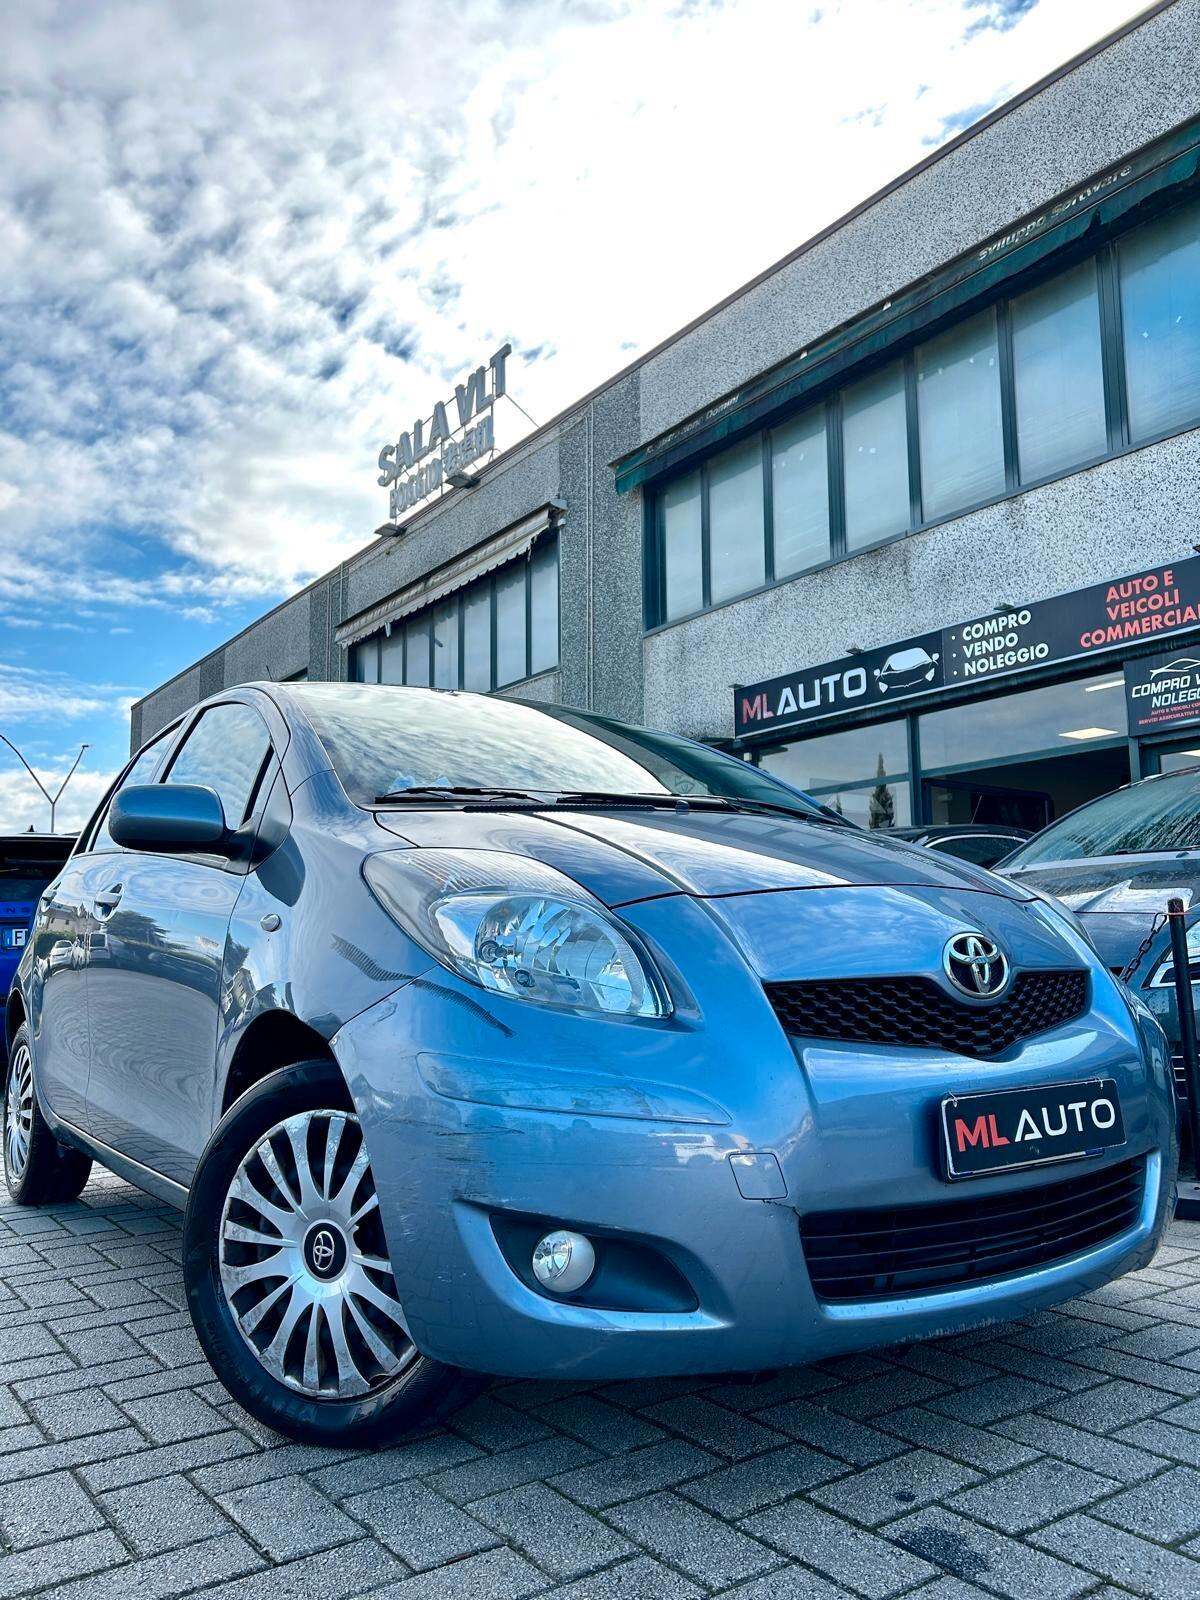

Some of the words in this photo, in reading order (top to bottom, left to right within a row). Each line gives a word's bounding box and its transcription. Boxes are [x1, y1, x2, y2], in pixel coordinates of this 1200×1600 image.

[977, 215, 1047, 261] Sviluppo
[1050, 164, 1133, 219] Software
[377, 400, 451, 488] SALA
[454, 342, 513, 427] VLT
[1106, 575, 1159, 603] AUTO
[1163, 569, 1174, 587] E
[1106, 588, 1180, 621] VEICOLI
[962, 610, 1032, 641] COMPRO
[963, 632, 1019, 659] VENDO
[964, 643, 1049, 677] NOLEGGIO
[741, 693, 775, 724] ML
[776, 667, 867, 717] AUTO
[1131, 675, 1191, 699] COMPRO
[954, 1114, 1011, 1153] ML
[1014, 1098, 1116, 1143] AUTO
